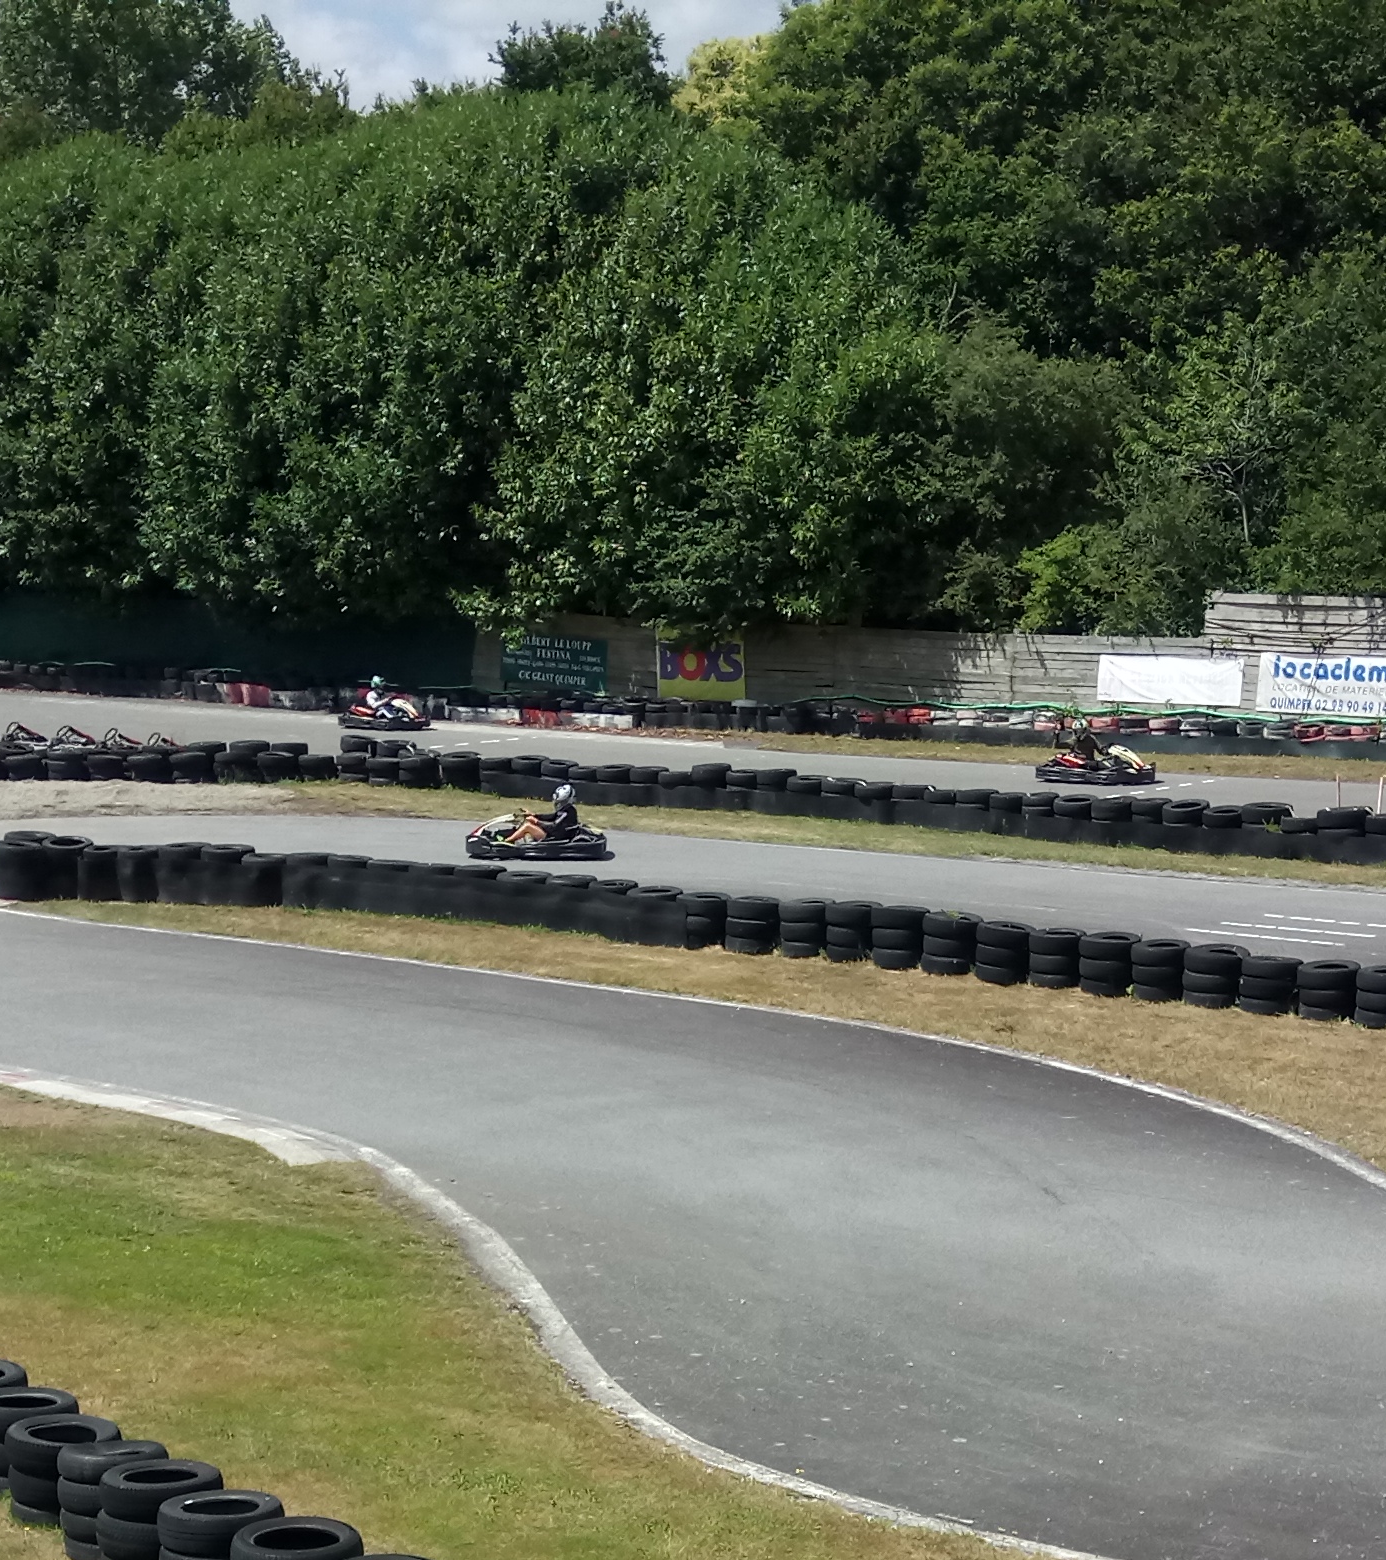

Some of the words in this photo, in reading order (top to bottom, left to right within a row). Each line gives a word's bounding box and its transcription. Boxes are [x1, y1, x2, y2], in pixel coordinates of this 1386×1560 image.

[536, 648, 571, 660] FESTINA
[1326, 686, 1339, 695] DE
[1315, 699, 1328, 711] 02
[1347, 700, 1359, 713] 90
[1362, 701, 1374, 713] 49
